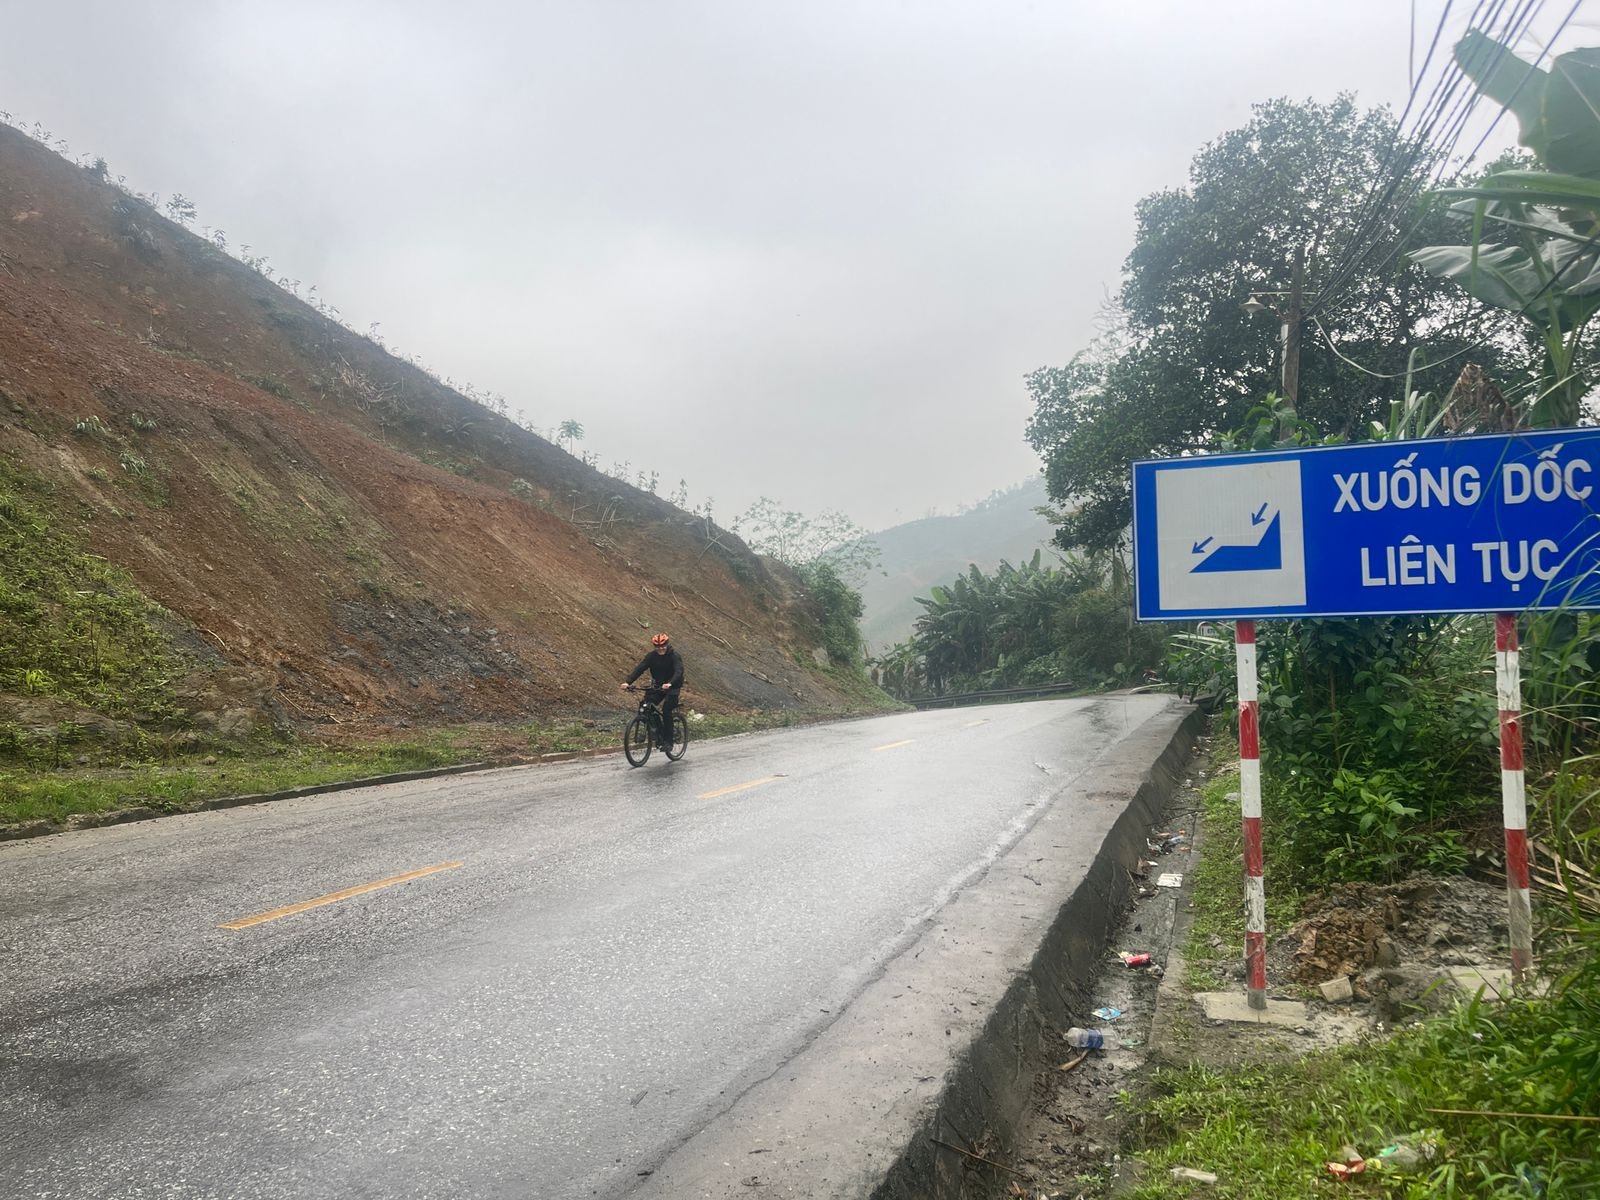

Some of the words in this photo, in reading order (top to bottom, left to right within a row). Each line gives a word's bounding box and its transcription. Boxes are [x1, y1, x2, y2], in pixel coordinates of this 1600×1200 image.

[1333, 452, 1481, 512] XUỐNG
[1503, 443, 1593, 505] DỐC
[1361, 534, 1456, 586] LIÊN
[1472, 538, 1560, 592] TỤC
